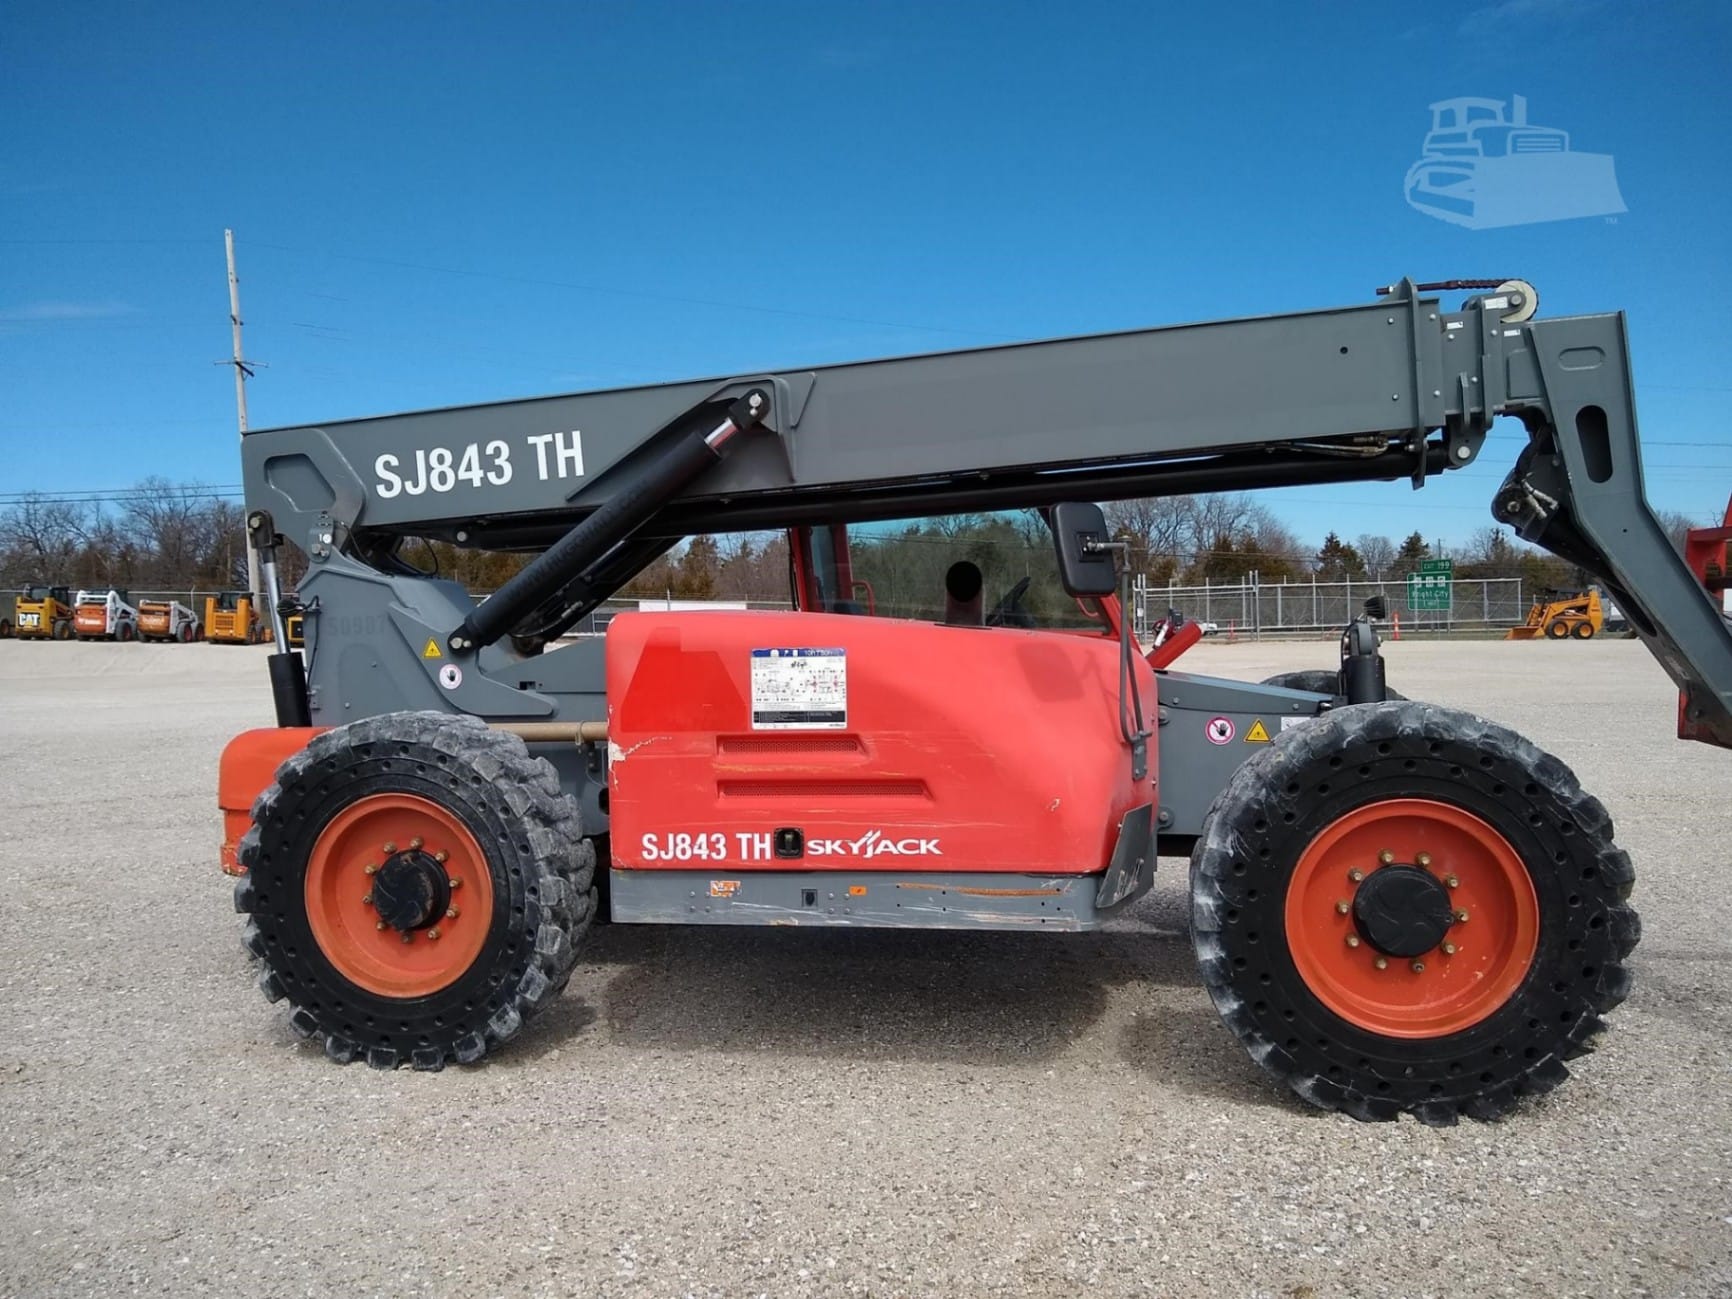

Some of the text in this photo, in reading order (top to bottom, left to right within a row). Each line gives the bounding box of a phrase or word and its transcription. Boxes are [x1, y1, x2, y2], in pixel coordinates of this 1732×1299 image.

[374, 430, 585, 498] SJ843 TH
[19, 613, 39, 626] CAT
[641, 829, 944, 861] SJ843 TH SKYJACK
